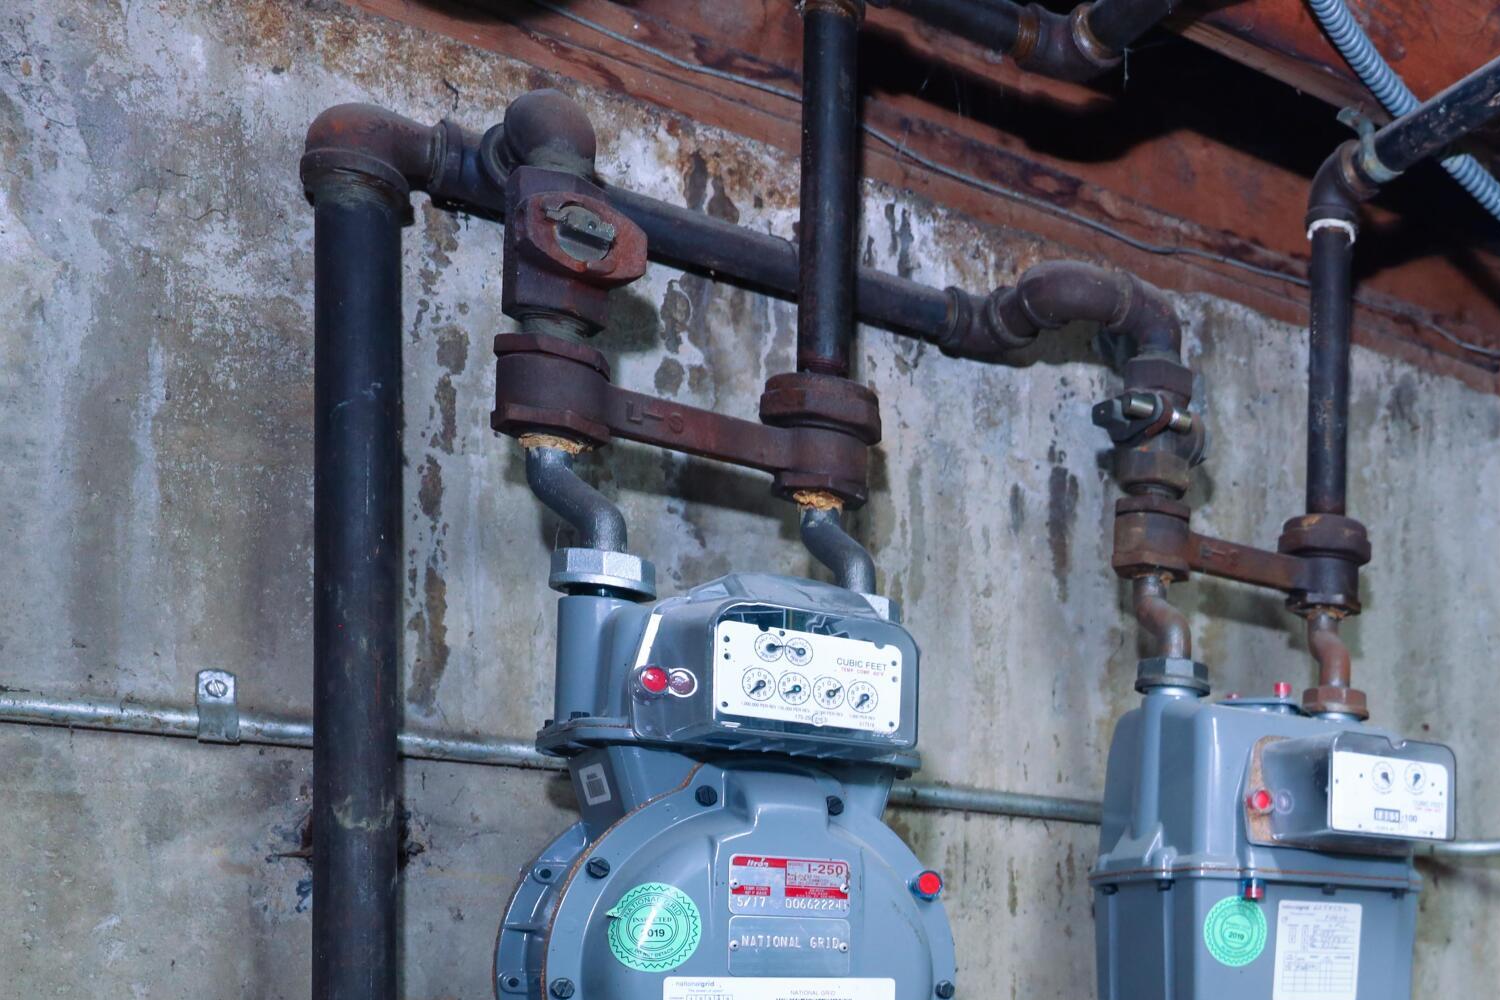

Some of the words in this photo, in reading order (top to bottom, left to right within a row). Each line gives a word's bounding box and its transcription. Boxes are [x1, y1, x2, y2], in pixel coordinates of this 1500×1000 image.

[836, 657, 864, 669] CUBIC
[866, 661, 888, 672] FEET
[808, 863, 844, 876] I-250
[663, 900, 683, 917] GRID
[737, 896, 767, 908] 5/17
[741, 935, 802, 949] NATIONAL
[809, 936, 841, 950] GRID
